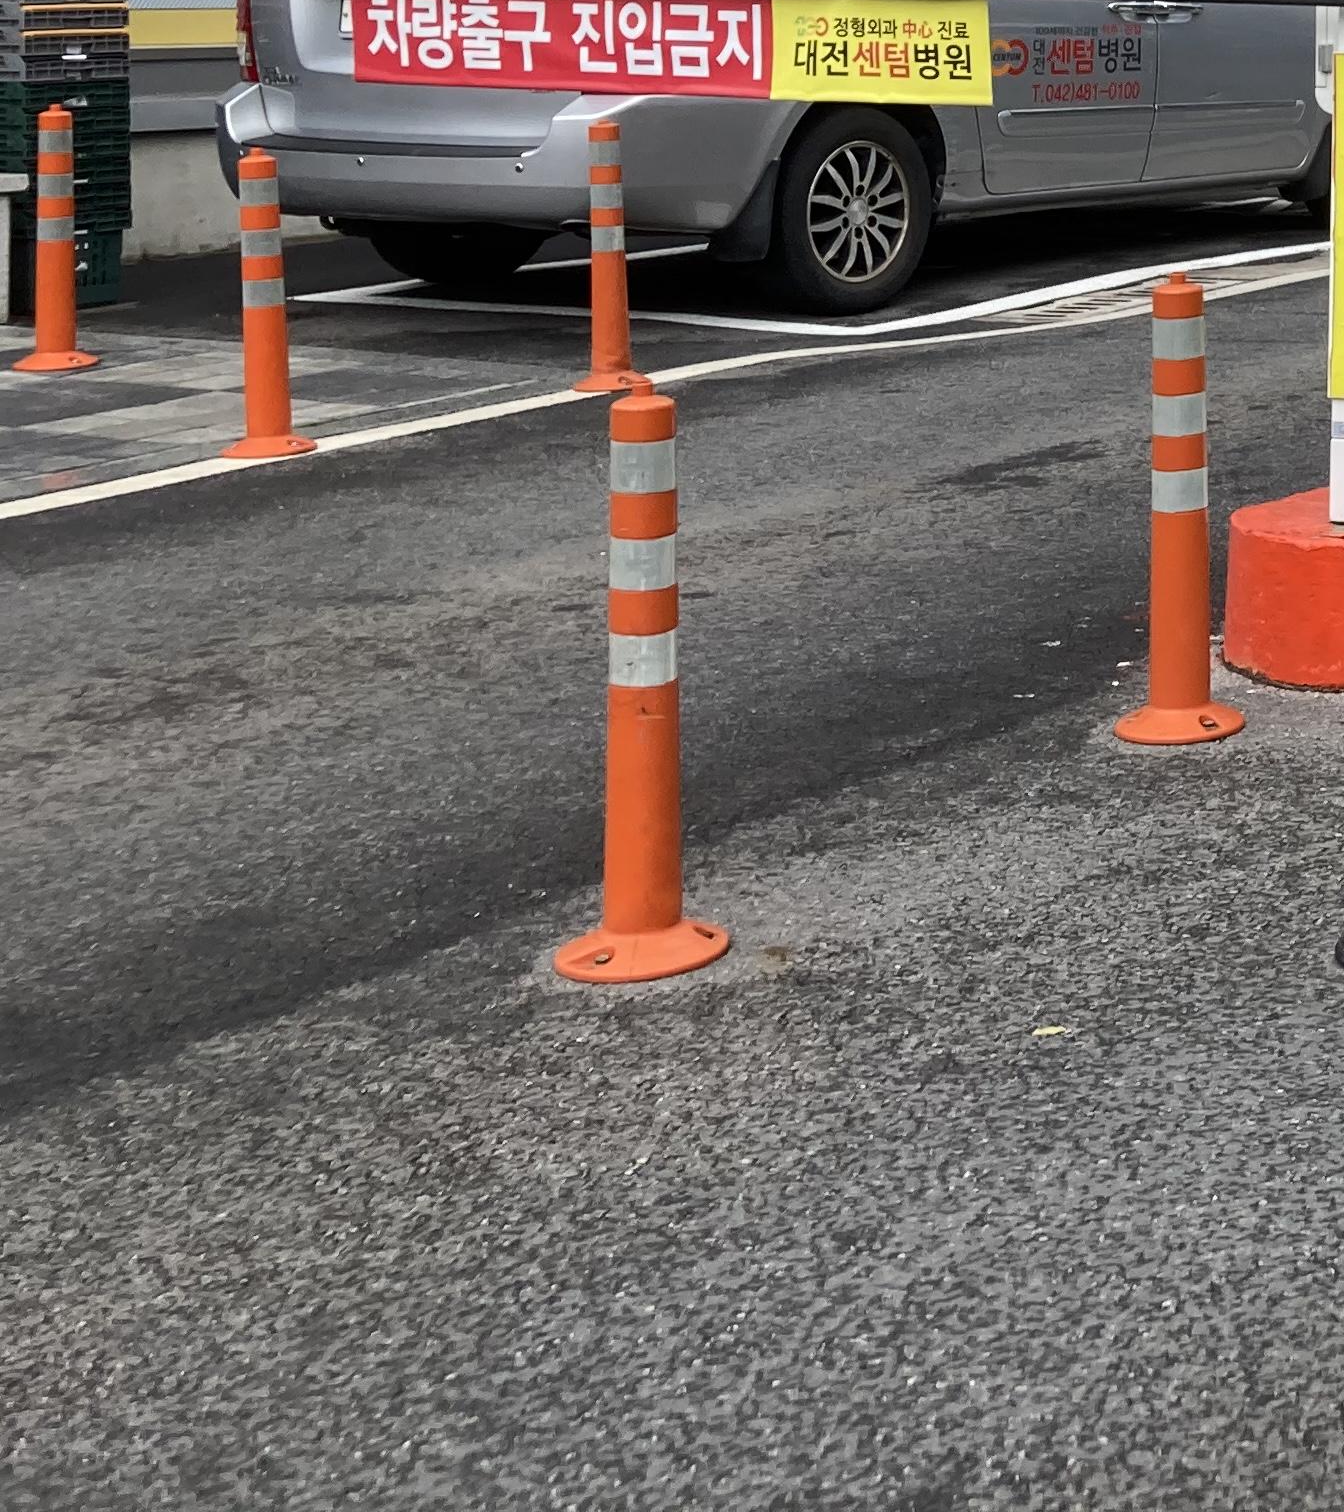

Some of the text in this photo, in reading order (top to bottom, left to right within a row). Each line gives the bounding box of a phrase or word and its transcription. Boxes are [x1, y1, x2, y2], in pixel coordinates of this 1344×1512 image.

[571, 0, 763, 81] 진입금지
[833, 17, 970, 40] 정형외과 中心 진료
[794, 39, 973, 81] 대전센텀병원
